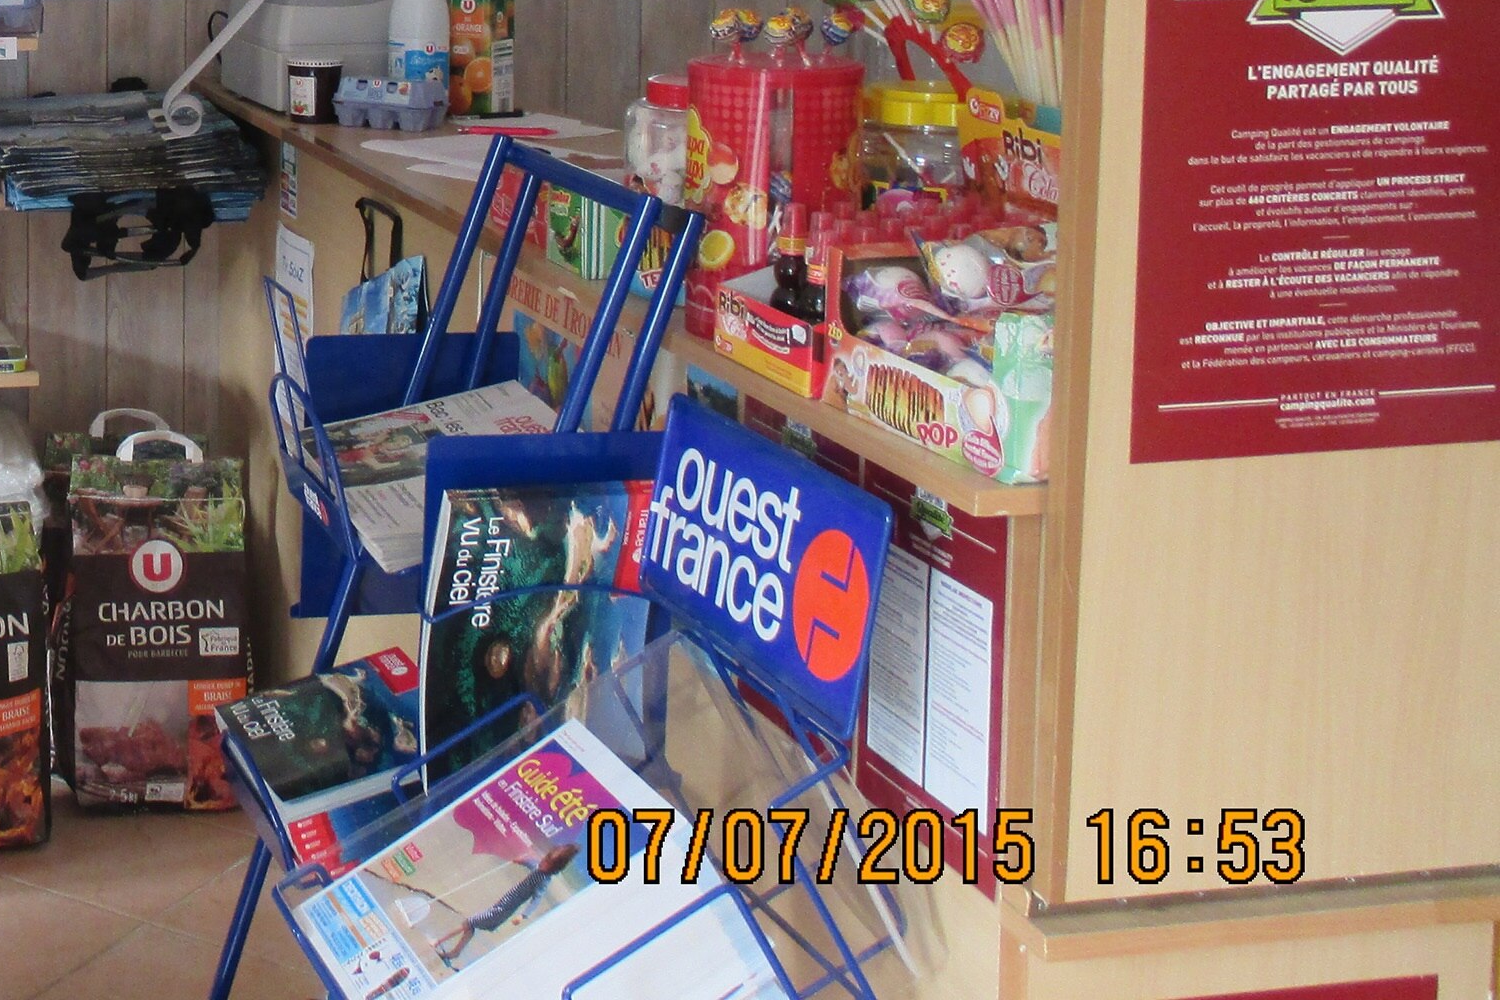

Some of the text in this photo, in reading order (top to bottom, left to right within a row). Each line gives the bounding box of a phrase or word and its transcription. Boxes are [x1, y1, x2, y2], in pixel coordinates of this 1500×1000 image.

[455, 23, 482, 33] ORANGE
[1248, 54, 1439, 81] L'ENGAGEMENT QUALITÉ
[1267, 77, 1418, 101] PARTAGÉ PAR TOUS
[1231, 120, 1450, 140] Camping Qualité ENGAGEMENT VOLONTAIRE
[1002, 127, 1043, 166] Ribi
[1376, 173, 1466, 187] UN PROCESS STRICT
[1266, 190, 1359, 204] CRITÈRES CONCRETS
[1271, 247, 1365, 262] CONTRÔLE RÉGULIER
[1333, 256, 1440, 271] DE FAÇON PERMANENTE
[1225, 271, 1390, 289] RESTER À L'ÉCOUTE DES VACANCIERS
[546, 294, 558, 322] DE
[1205, 316, 1326, 332] OBJECTIVE ET IMPARTIALE,
[1194, 332, 1245, 345] RECONNUE
[1314, 333, 1438, 350] AVEC LES CONSOMMATEURS
[1280, 388, 1376, 401] PARTOUT EN FRANCE
[1280, 397, 1376, 412] campingqualite.com
[916, 422, 959, 449] POP
[675, 447, 801, 574] ouest
[487, 516, 505, 535] Le
[143, 552, 172, 581] U
[449, 517, 482, 606] Vu du Ciel
[650, 485, 784, 643] france
[98, 598, 226, 623] CHARBON
[106, 624, 192, 647] DE BOIS
[150, 648, 189, 659] BARBECUE
[210, 644, 238, 652] France
[257, 699, 296, 742] Finistère
[517, 758, 560, 801] Guide
[550, 787, 599, 828] été
[504, 781, 542, 822] Finistère
[535, 813, 564, 838] Sud
